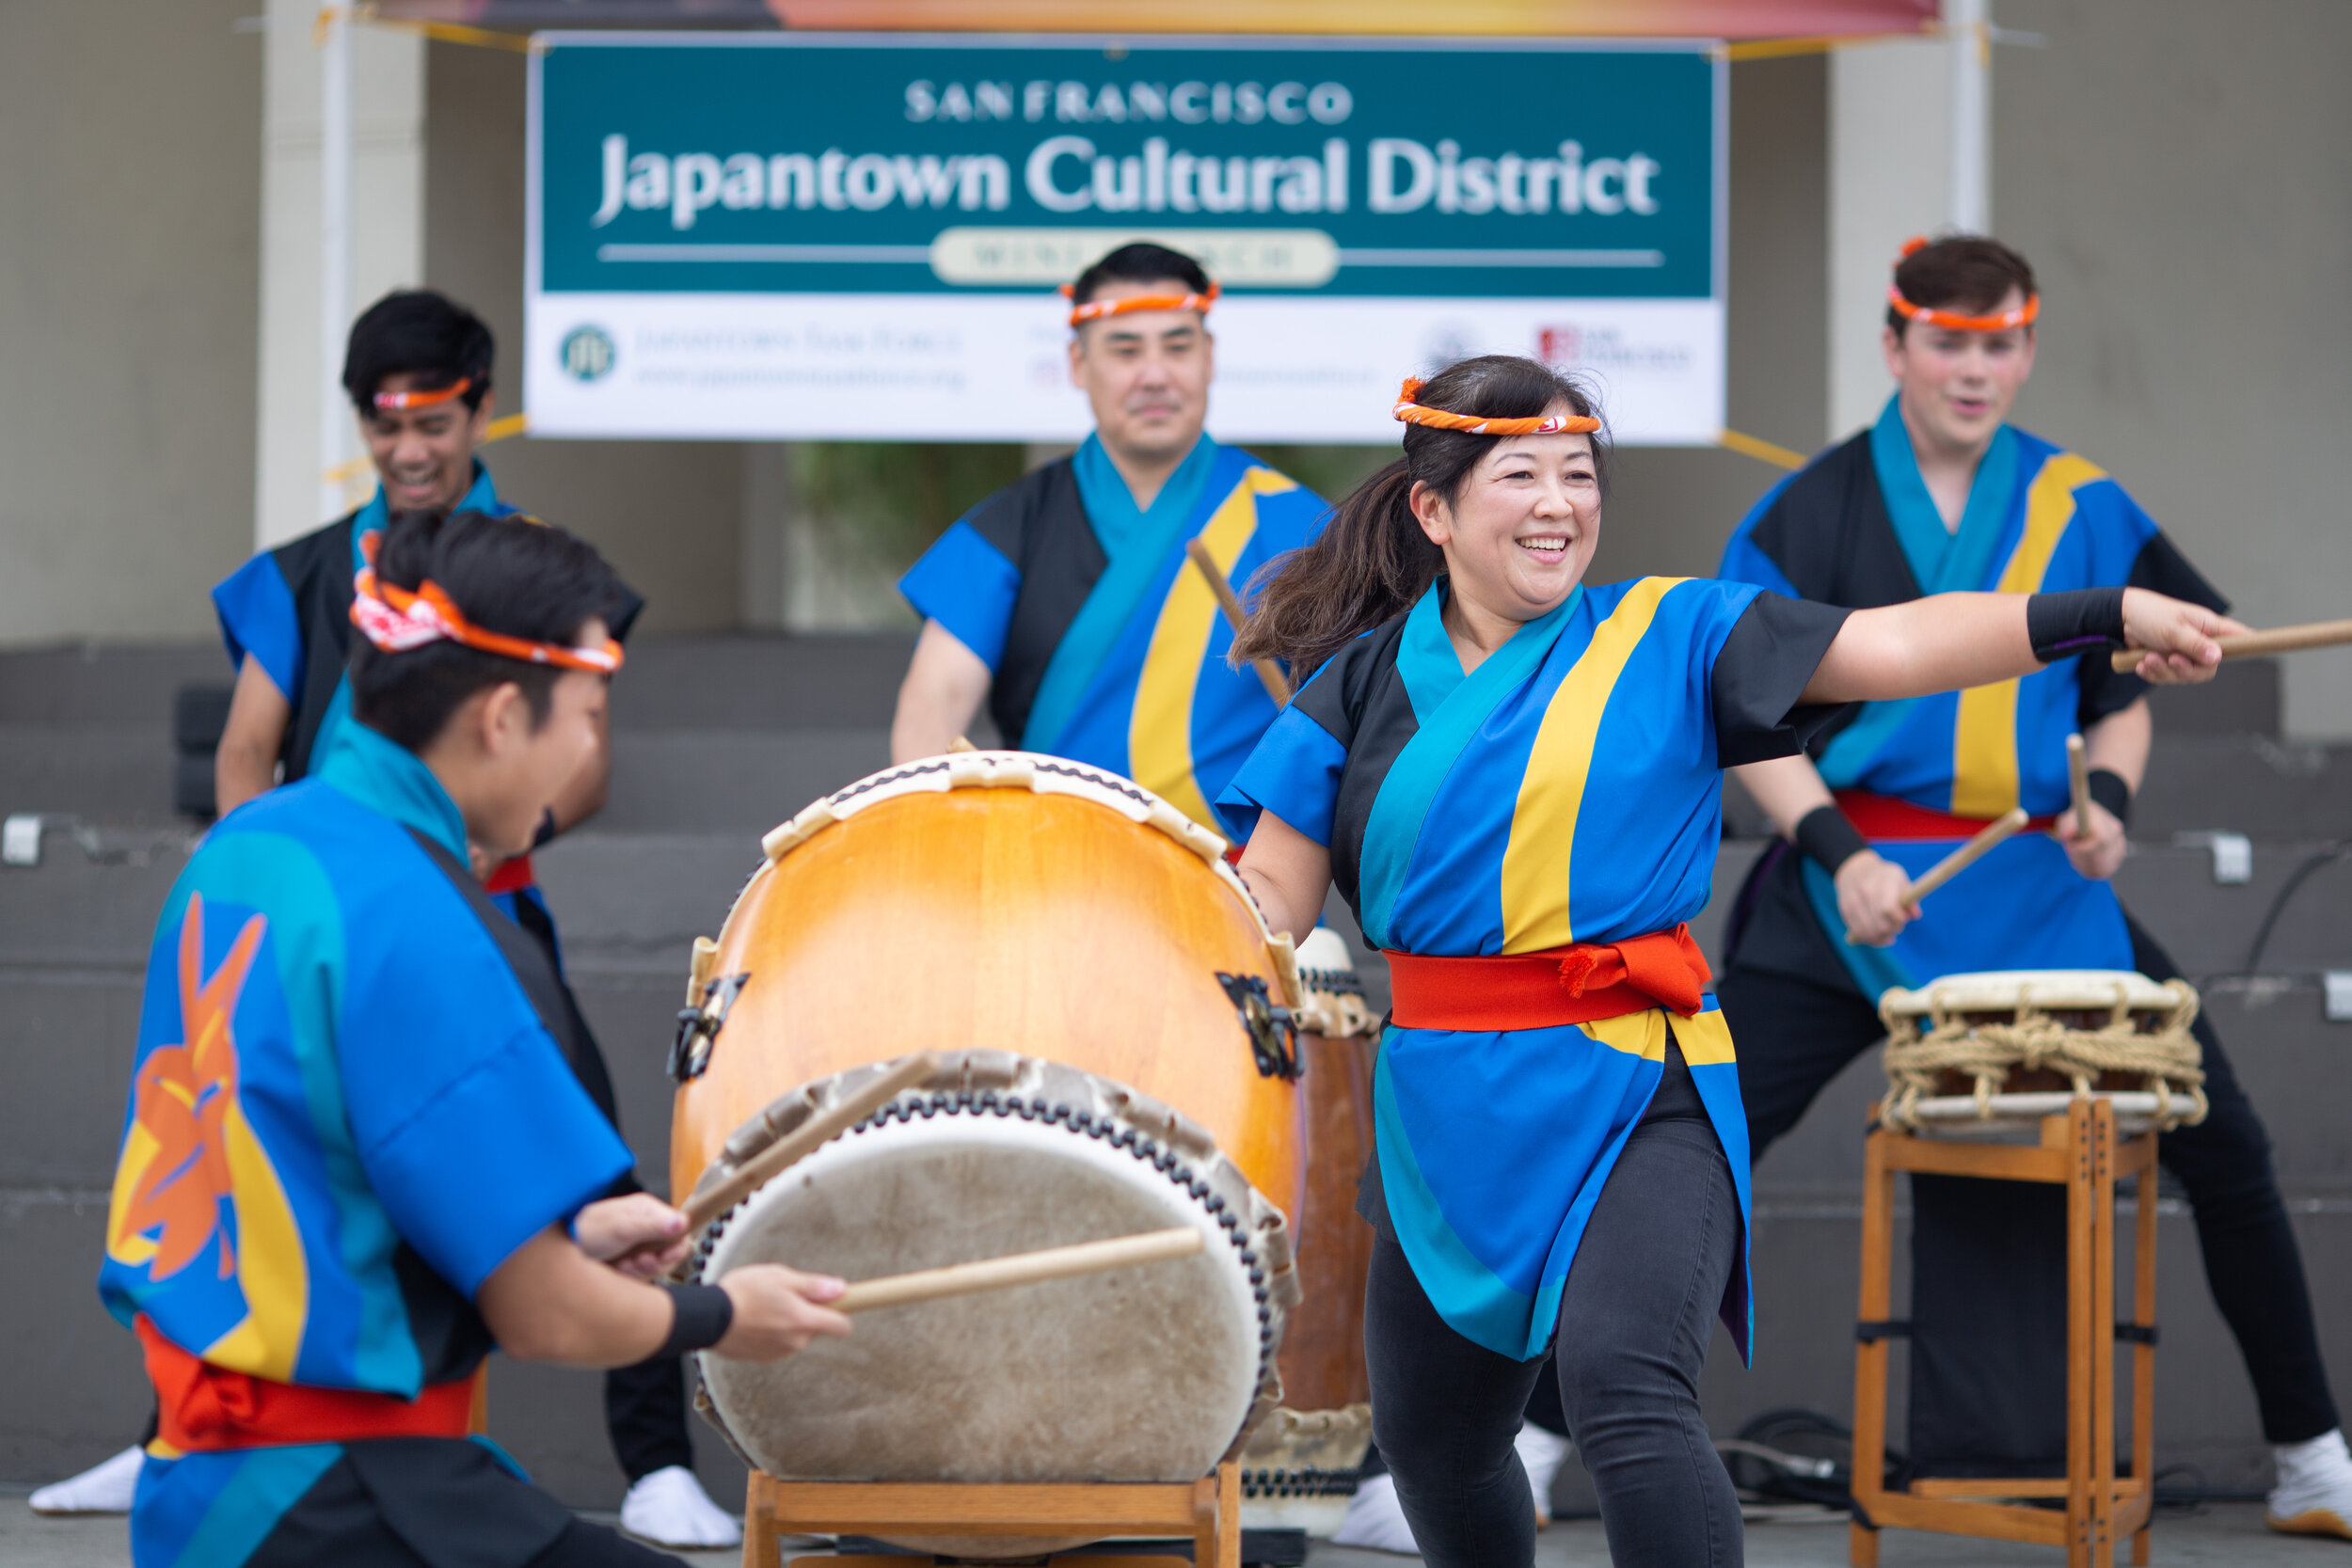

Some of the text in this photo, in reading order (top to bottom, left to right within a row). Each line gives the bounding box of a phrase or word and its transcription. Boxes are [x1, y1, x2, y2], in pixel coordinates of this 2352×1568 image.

[905, 80, 1352, 124] SAN FRANCISCO
[592, 134, 1659, 230] Japantown Cultural District
